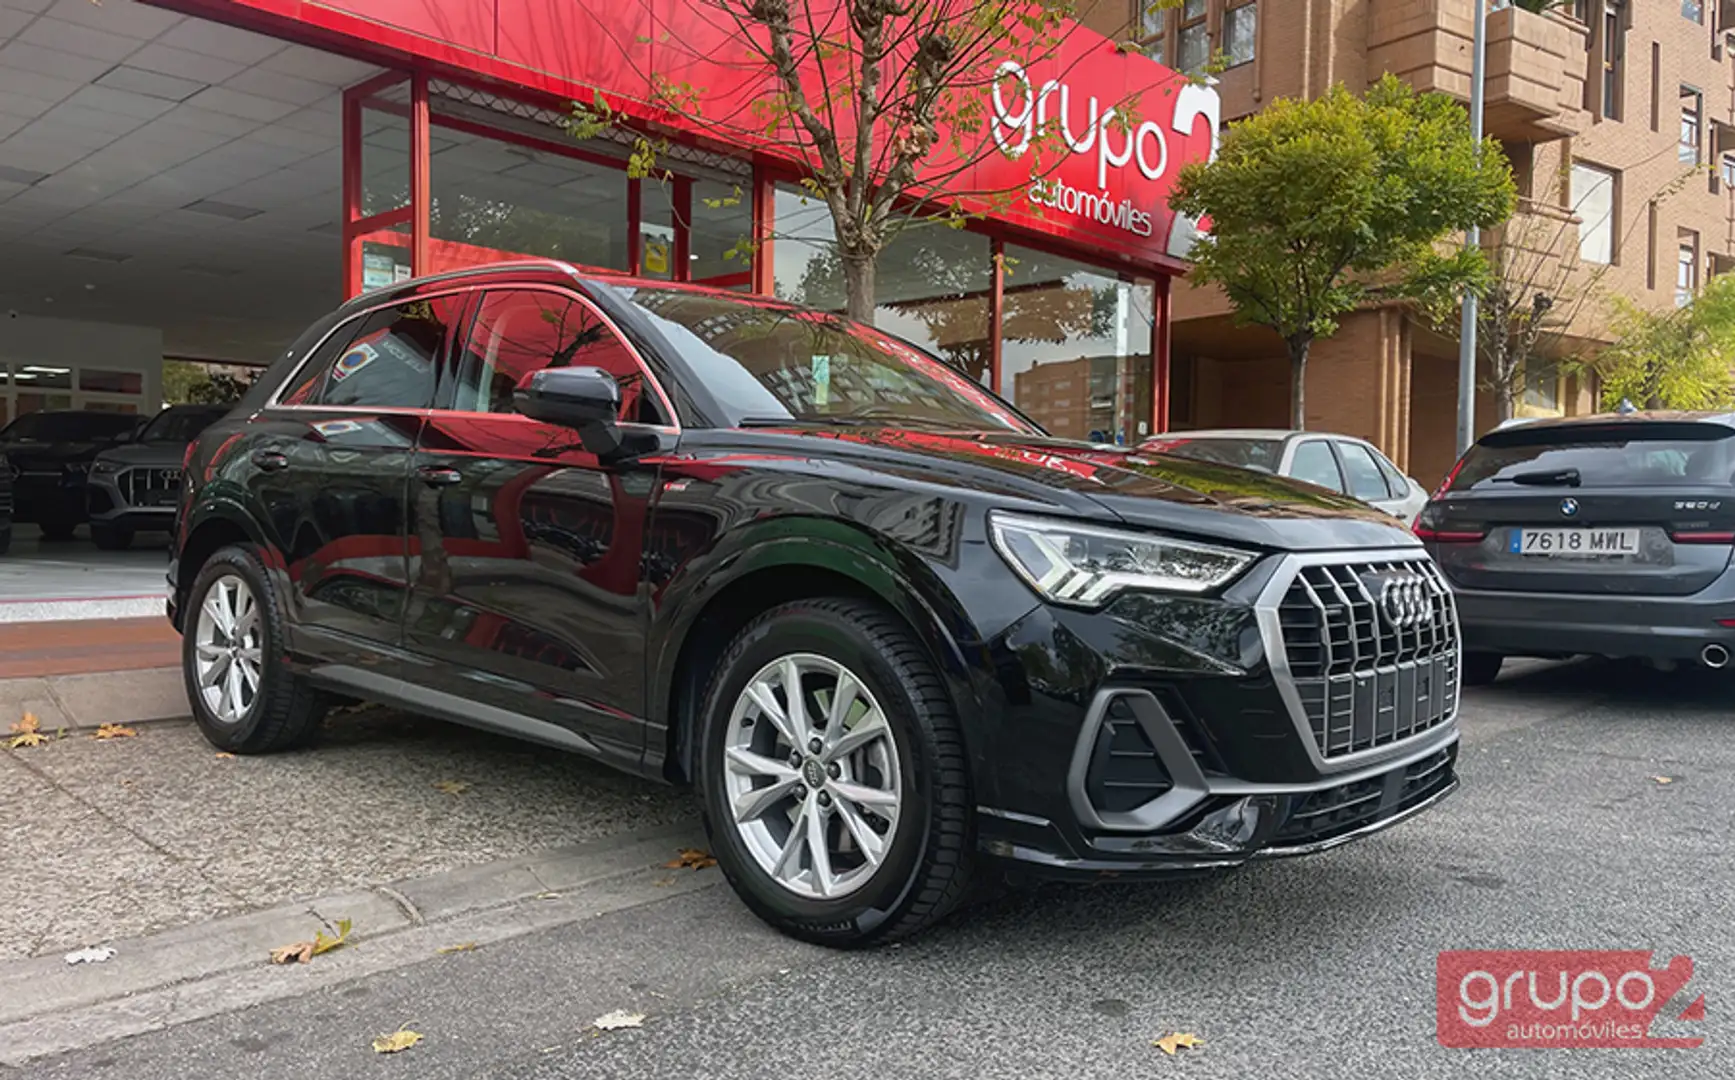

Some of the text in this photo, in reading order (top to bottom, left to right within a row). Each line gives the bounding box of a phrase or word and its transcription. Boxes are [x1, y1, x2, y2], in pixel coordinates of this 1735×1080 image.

[991, 61, 1168, 190] grupo
[1027, 174, 1153, 238] automóviles
[1526, 532, 1634, 550] 7618 MWL
